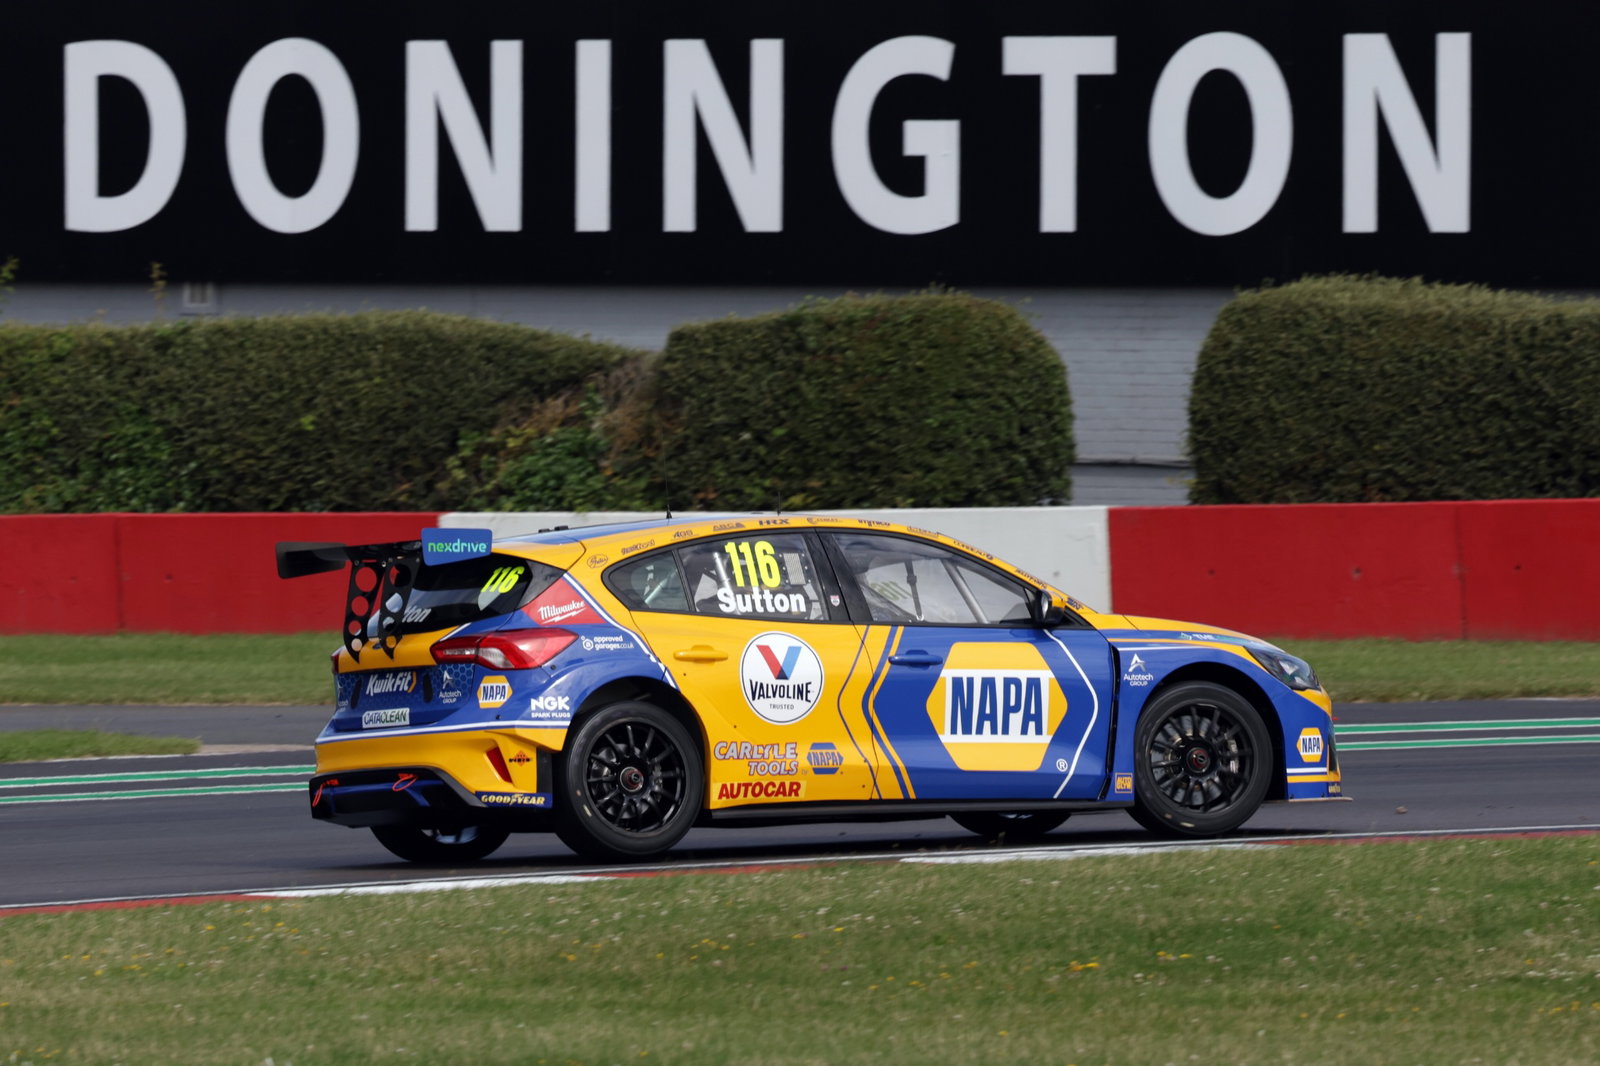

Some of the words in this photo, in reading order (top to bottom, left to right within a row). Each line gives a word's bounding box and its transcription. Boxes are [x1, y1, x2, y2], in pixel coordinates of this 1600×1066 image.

[63, 31, 1473, 237] DONINGTON
[428, 538, 487, 553] nexdrive
[725, 541, 781, 588] 116
[481, 566, 525, 594] 116
[717, 588, 806, 613] Sutton
[538, 600, 586, 619] Milwaukee
[594, 635, 623, 643] approved
[594, 642, 634, 650] garages.co.uk
[1123, 673, 1154, 681] Autotech
[439, 690, 462, 698] Autotech
[482, 685, 507, 702] NAPA
[749, 678, 812, 703] VALVOLINE
[530, 696, 570, 711] NGK
[769, 703, 795, 711] TRUSTED
[950, 676, 1044, 736] NAPA
[363, 712, 408, 726] CATACLEAN
[552, 711, 571, 719] PLUGS
[714, 741, 798, 760] CARLYLE
[1302, 737, 1321, 754] NAPA
[813, 751, 840, 766] NAPA
[748, 761, 798, 776] TOOLS
[718, 781, 802, 800] AUTOCAR
[481, 794, 546, 806] GOODYEAR
